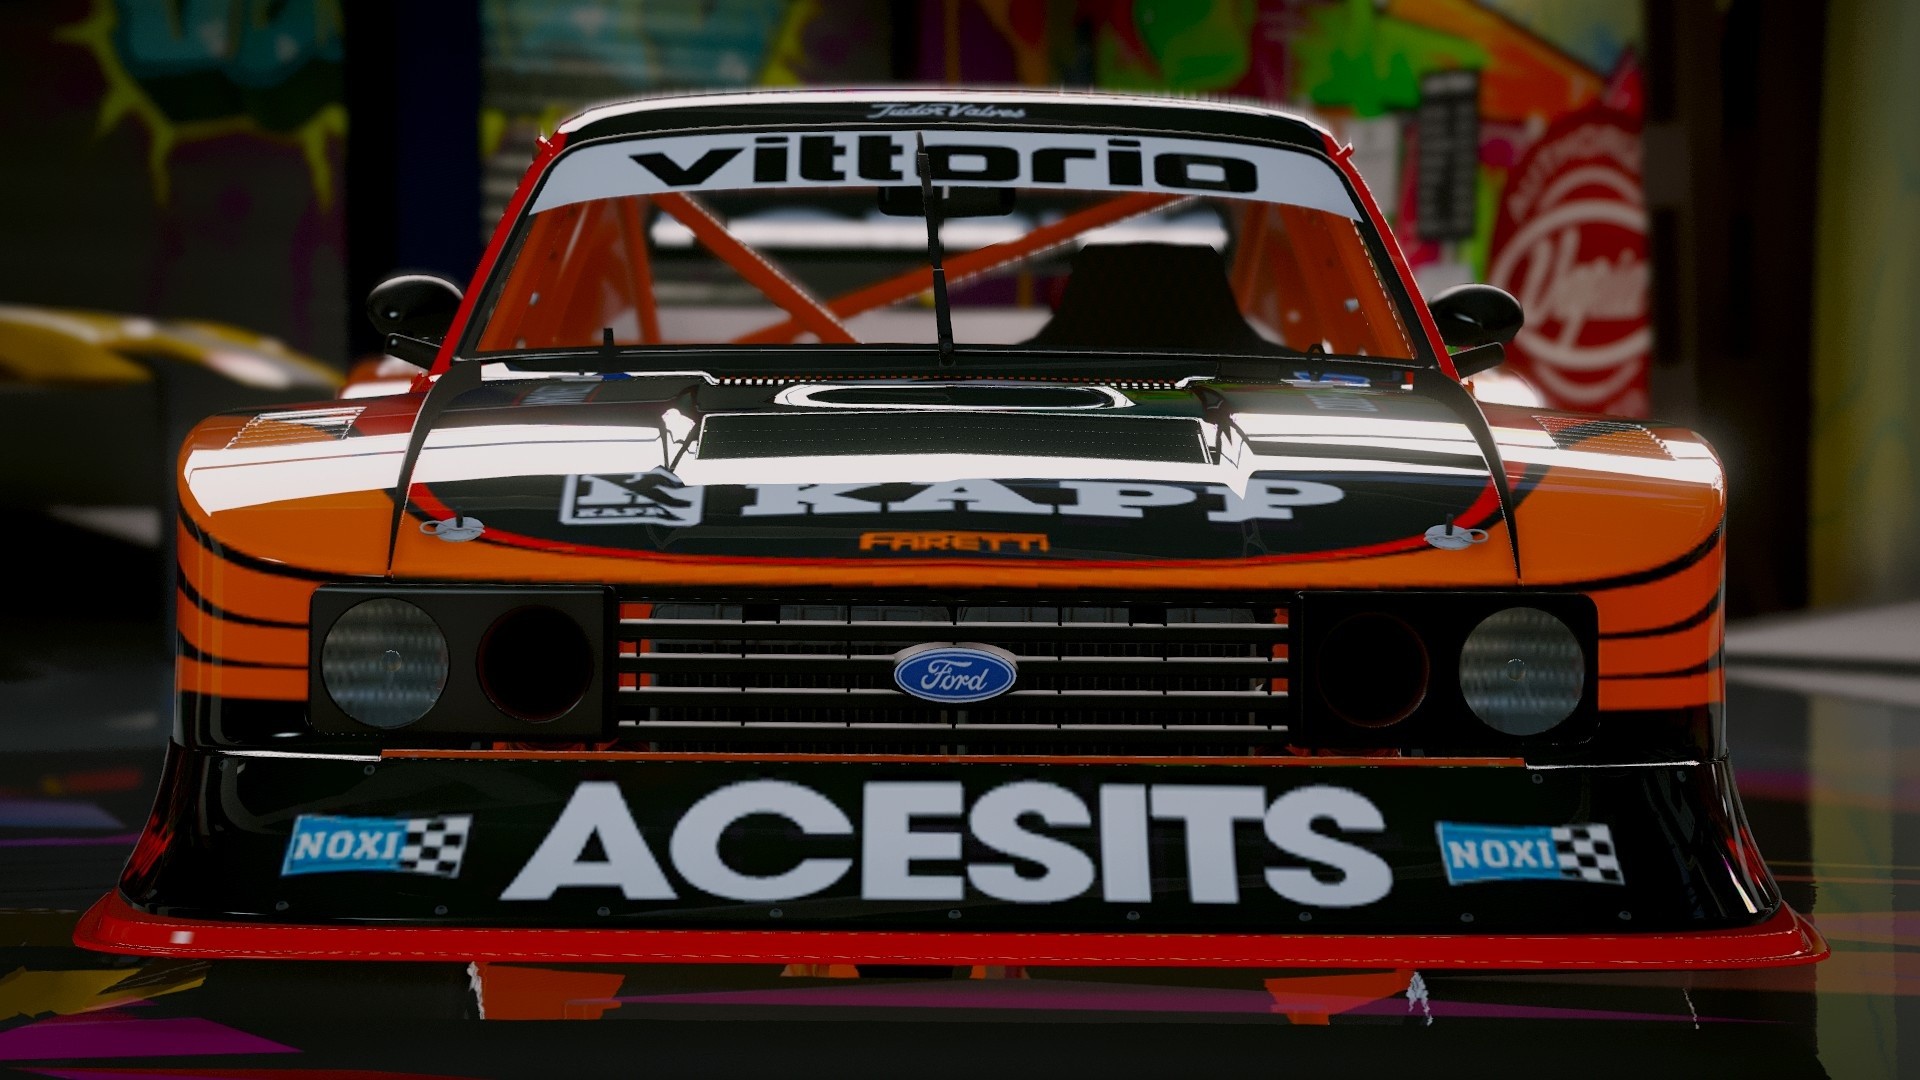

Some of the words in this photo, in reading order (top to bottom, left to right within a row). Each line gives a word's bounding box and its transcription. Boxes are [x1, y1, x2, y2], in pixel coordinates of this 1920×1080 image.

[866, 103, 946, 119] Tudor
[930, 103, 1026, 119] Valves
[629, 135, 1258, 193] vittorio
[740, 478, 1345, 522] KAPP
[859, 530, 1050, 552] FARETTI
[920, 659, 990, 691] Ford
[293, 829, 401, 861] NOXI
[497, 778, 1395, 909] ACESITS
[1446, 838, 1556, 870] NOXI
